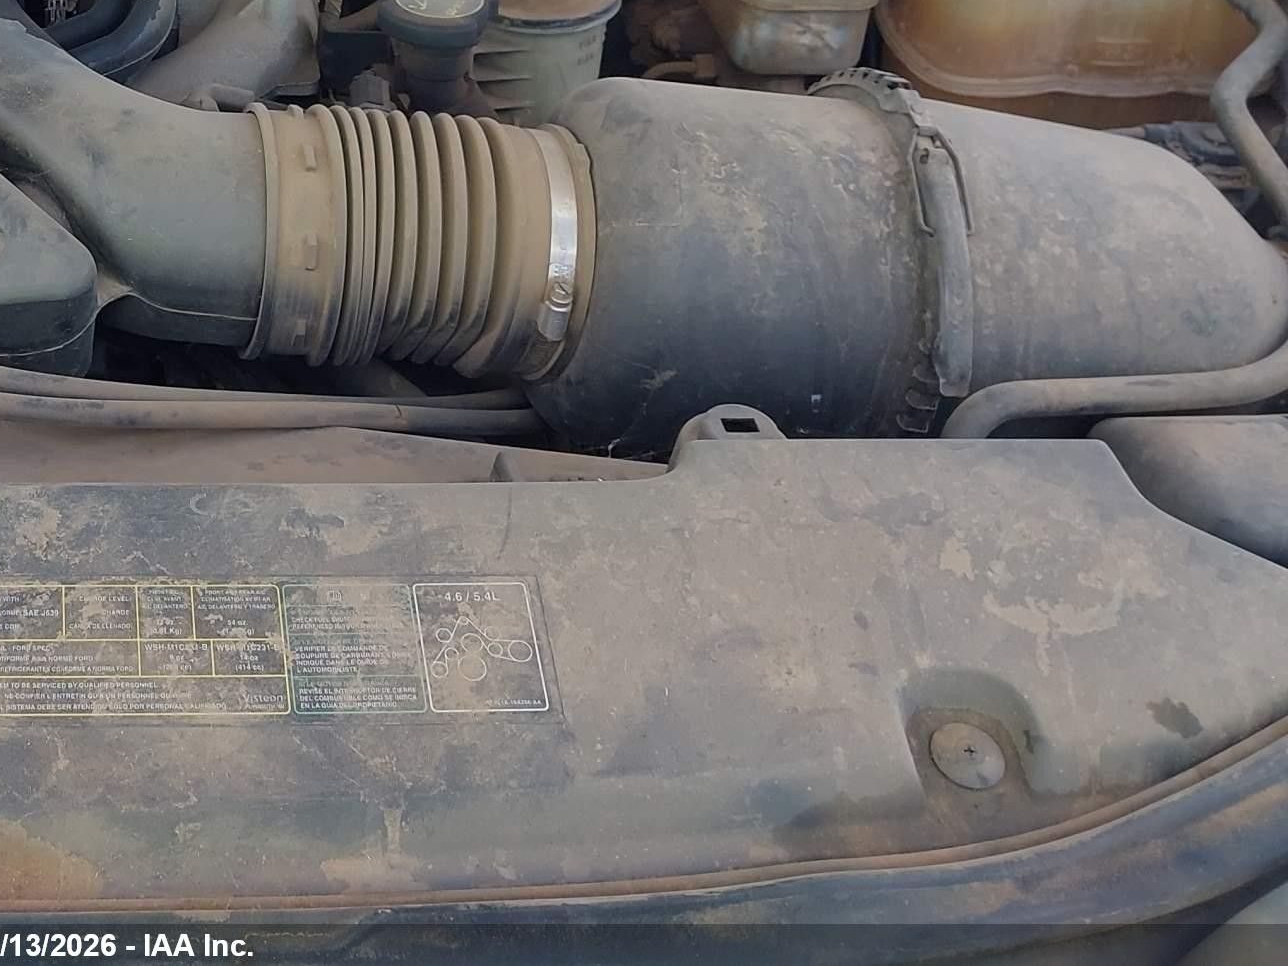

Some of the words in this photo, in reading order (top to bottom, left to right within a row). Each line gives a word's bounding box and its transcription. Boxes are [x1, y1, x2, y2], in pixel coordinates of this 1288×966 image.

[444, 592, 462, 602] 4.6
[473, 591, 502, 601] 5.4L
[23, 609, 40, 617] SAE
[242, 694, 283, 702] Visteon
